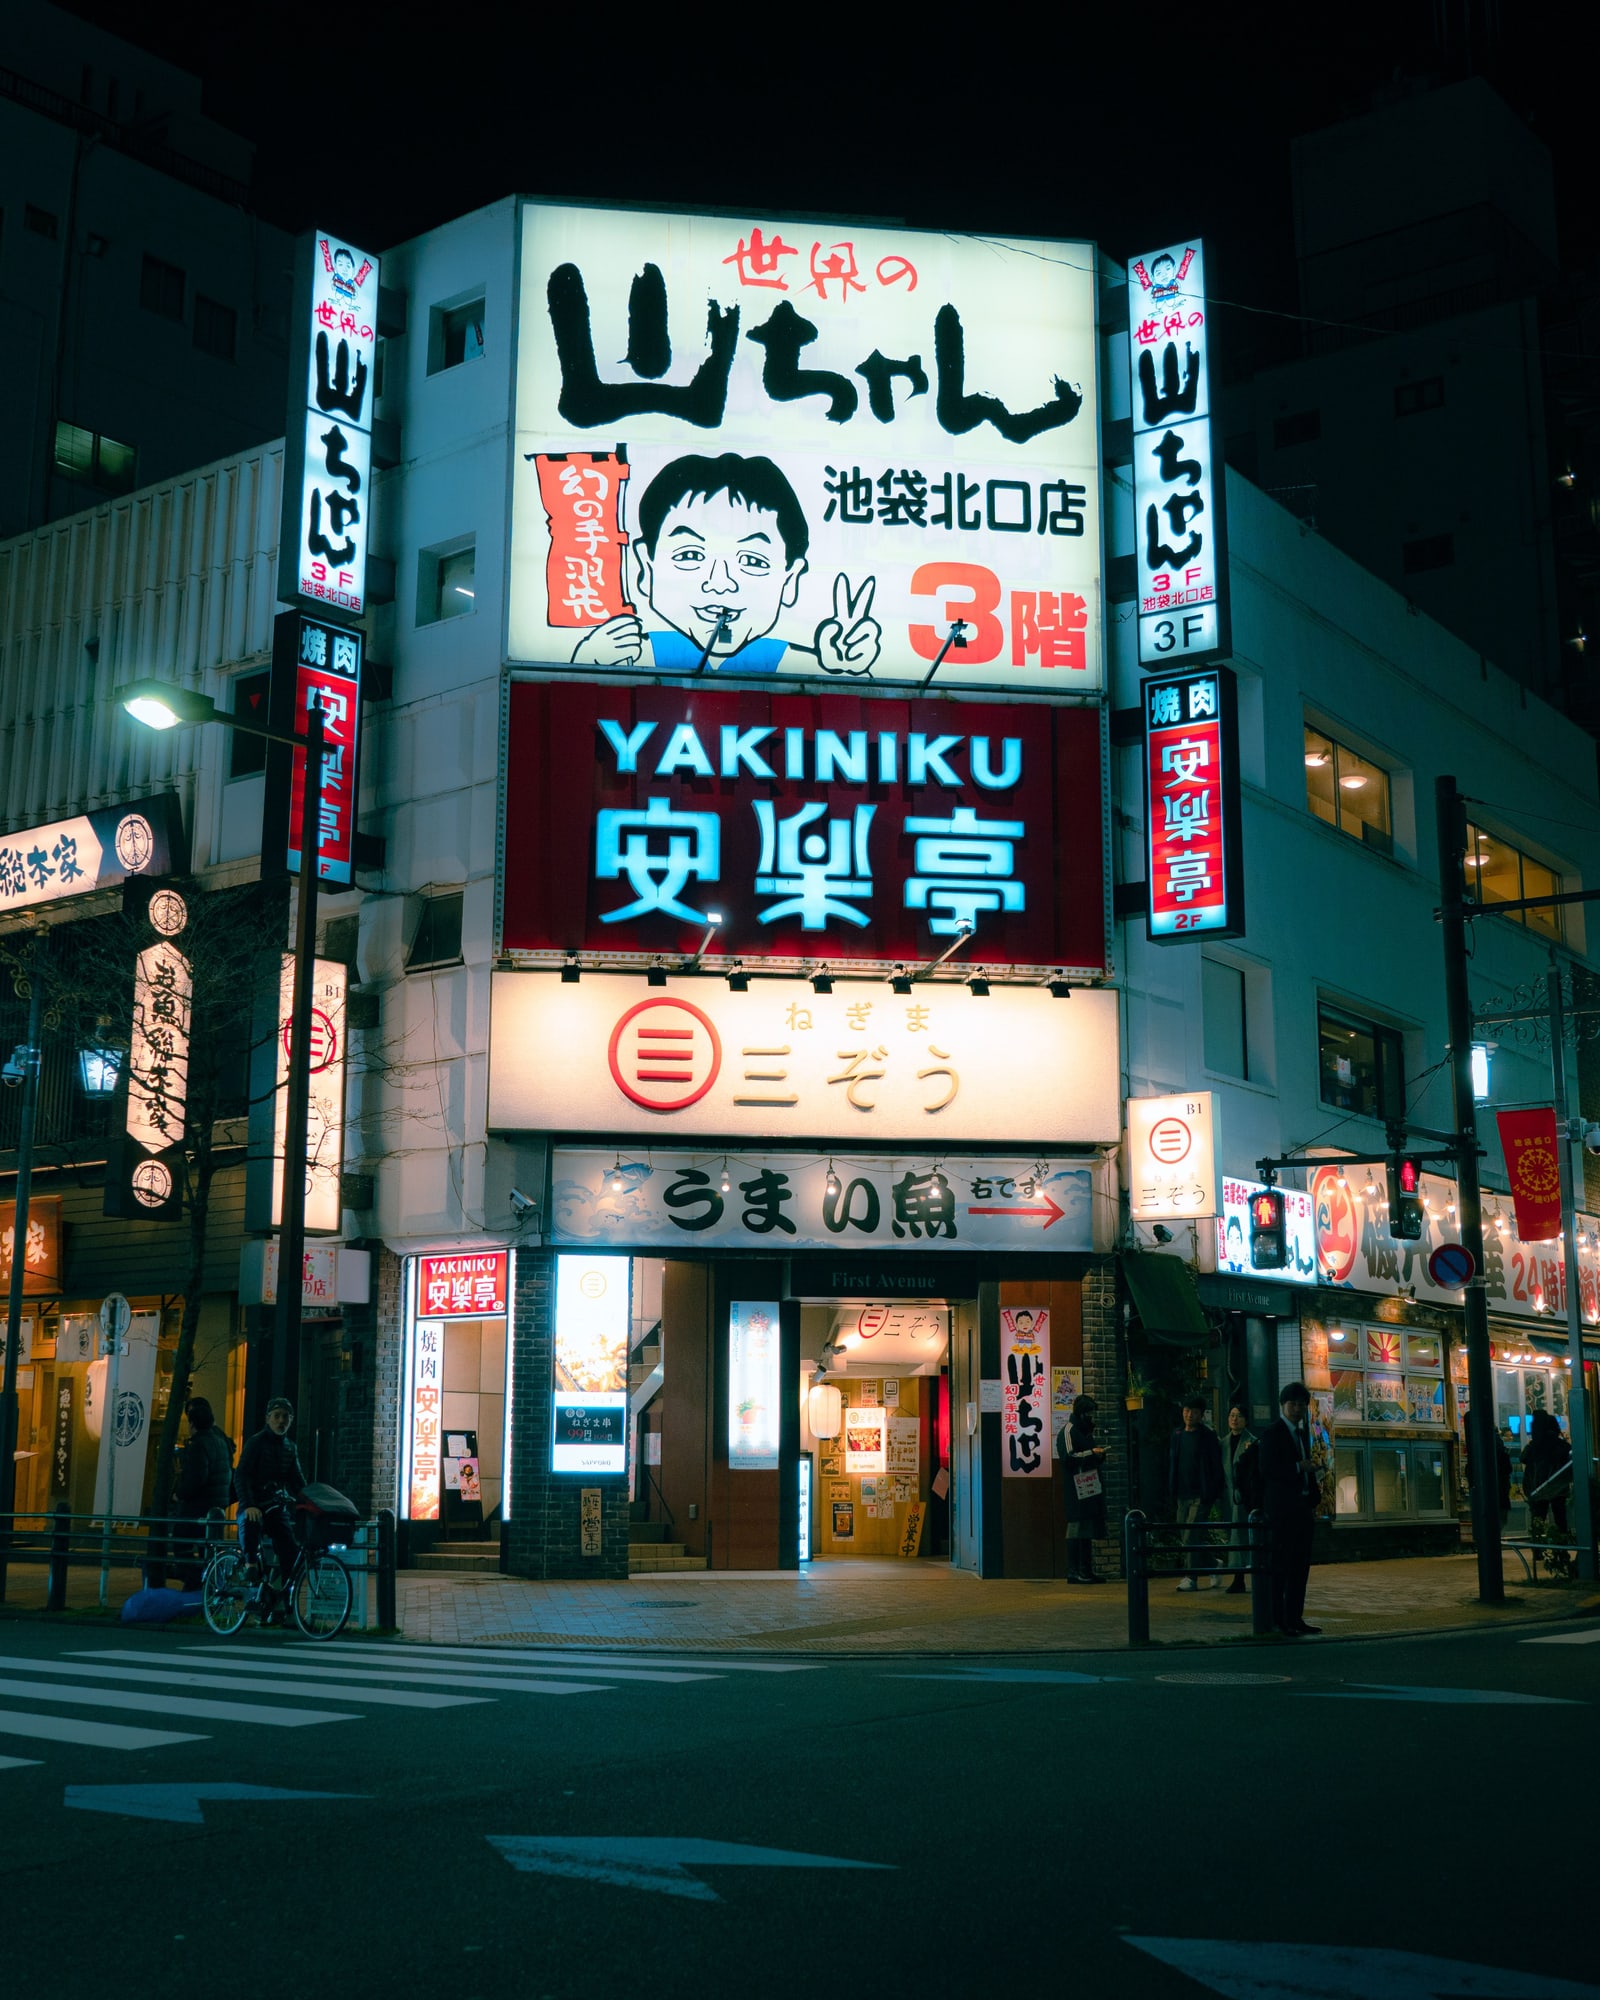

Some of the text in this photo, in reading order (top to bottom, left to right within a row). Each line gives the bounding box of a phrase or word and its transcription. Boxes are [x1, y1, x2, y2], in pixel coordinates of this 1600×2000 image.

[722, 228, 918, 303] 世界の
[314, 300, 373, 342] 世界の
[1133, 310, 1204, 344] 世界の
[547, 262, 1083, 443] 山ちゃん
[308, 329, 368, 569] 山ちゃん
[1138, 340, 1204, 572] 山ちゃん
[823, 465, 1088, 536] 池袋北口店
[560, 464, 610, 620] 幻の手羽先
[300, 579, 361, 611] 池袋北口店
[908, 561, 1088, 671] 3階
[1142, 585, 1214, 612] 池袋北口店
[301, 625, 359, 676] 焼肉
[1153, 613, 1205, 653] 3F
[1151, 680, 1217, 725] 焼肉
[597, 718, 1023, 791] YAKINIKU
[1174, 913, 1203, 930] 2F
[325, 985, 341, 998] B1
[786, 1001, 930, 1032] ねぎま
[732, 1044, 961, 1113] 三ぞう
[1187, 1103, 1202, 1115] B1
[663, 1168, 958, 1240] うまい魚
[1140, 1184, 1205, 1207] 三ぞう
[429, 1258, 496, 1273] YAKINIKU
[831, 1272, 936, 1289] First Avenue
[884, 1315, 940, 1339] 三ぞう
[420, 1330, 437, 1379] 焼肉
[572, 1417, 611, 1428] ねぎま串
[1005, 1384, 1018, 1434] 幻の手羽先
[1008, 1353, 1045, 1473] 山ちゃん
[902, 1515, 920, 1557] 営業中
